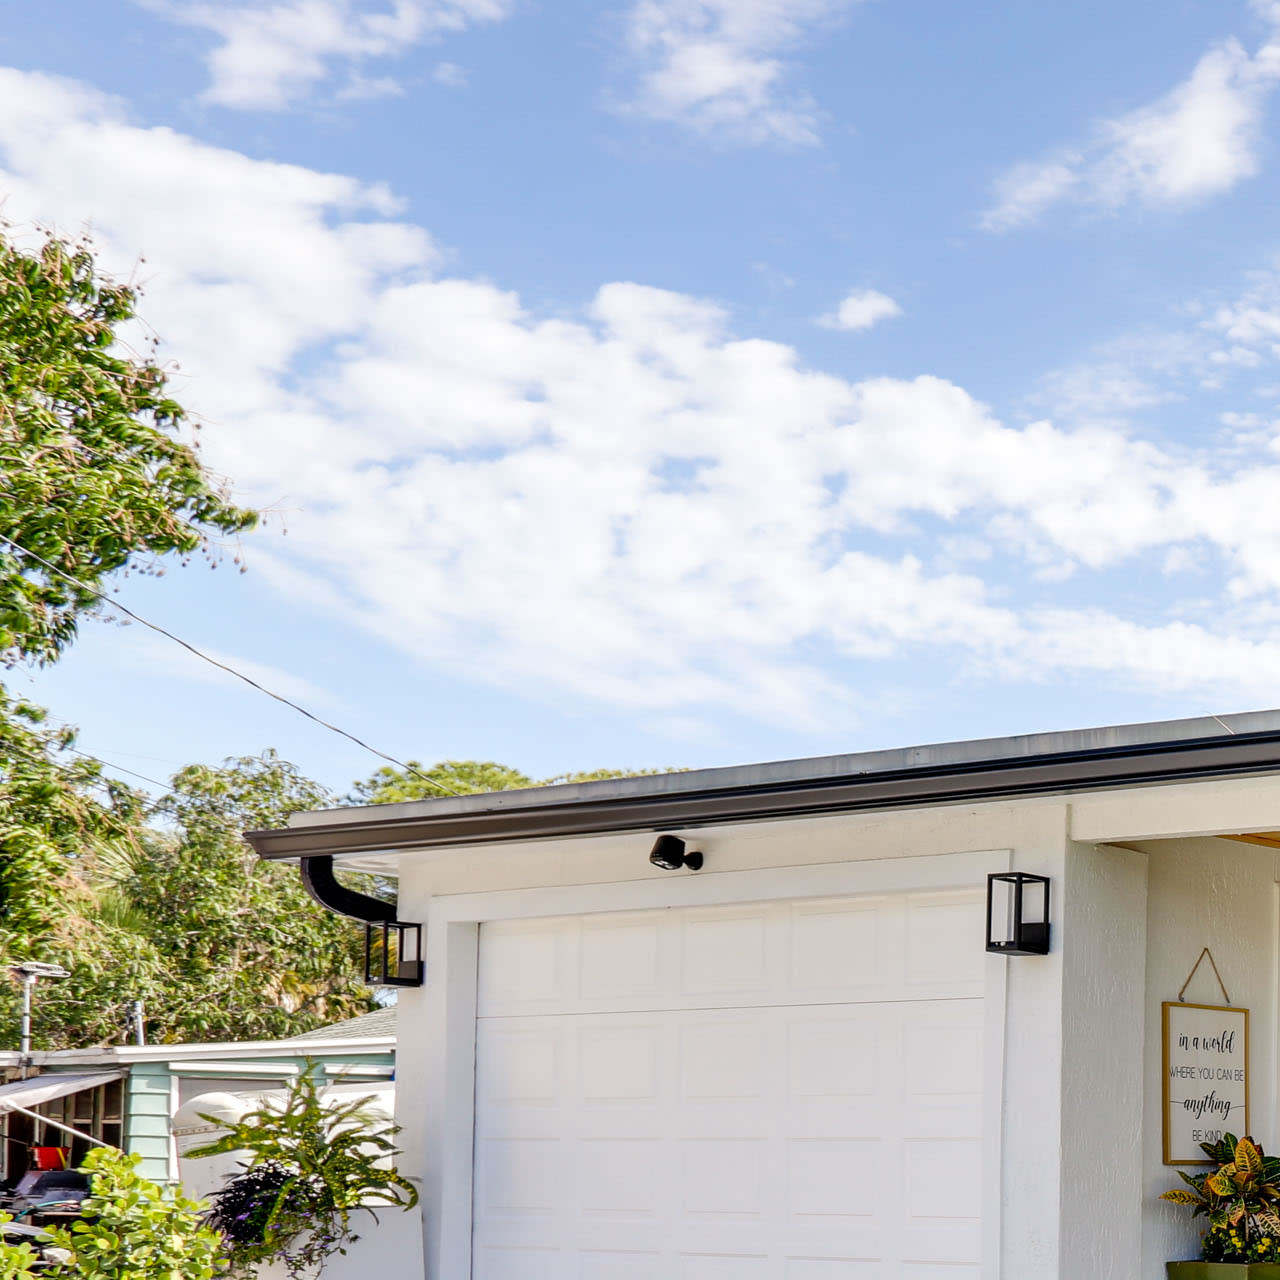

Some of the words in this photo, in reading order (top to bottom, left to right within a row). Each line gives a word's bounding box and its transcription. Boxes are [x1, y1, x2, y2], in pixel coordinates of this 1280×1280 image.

[1179, 1033, 1188, 1051] in
[1193, 1037, 1199, 1050] a
[1203, 1030, 1235, 1053] world
[1170, 1066, 1196, 1079] WHERE
[1199, 1067, 1214, 1080] YOU
[1217, 1068, 1232, 1080] CAN
[1234, 1069, 1244, 1082] BE
[1183, 1090, 1231, 1120] anything
[1192, 1129, 1203, 1142] BE
[1205, 1130, 1222, 1142] KIND
